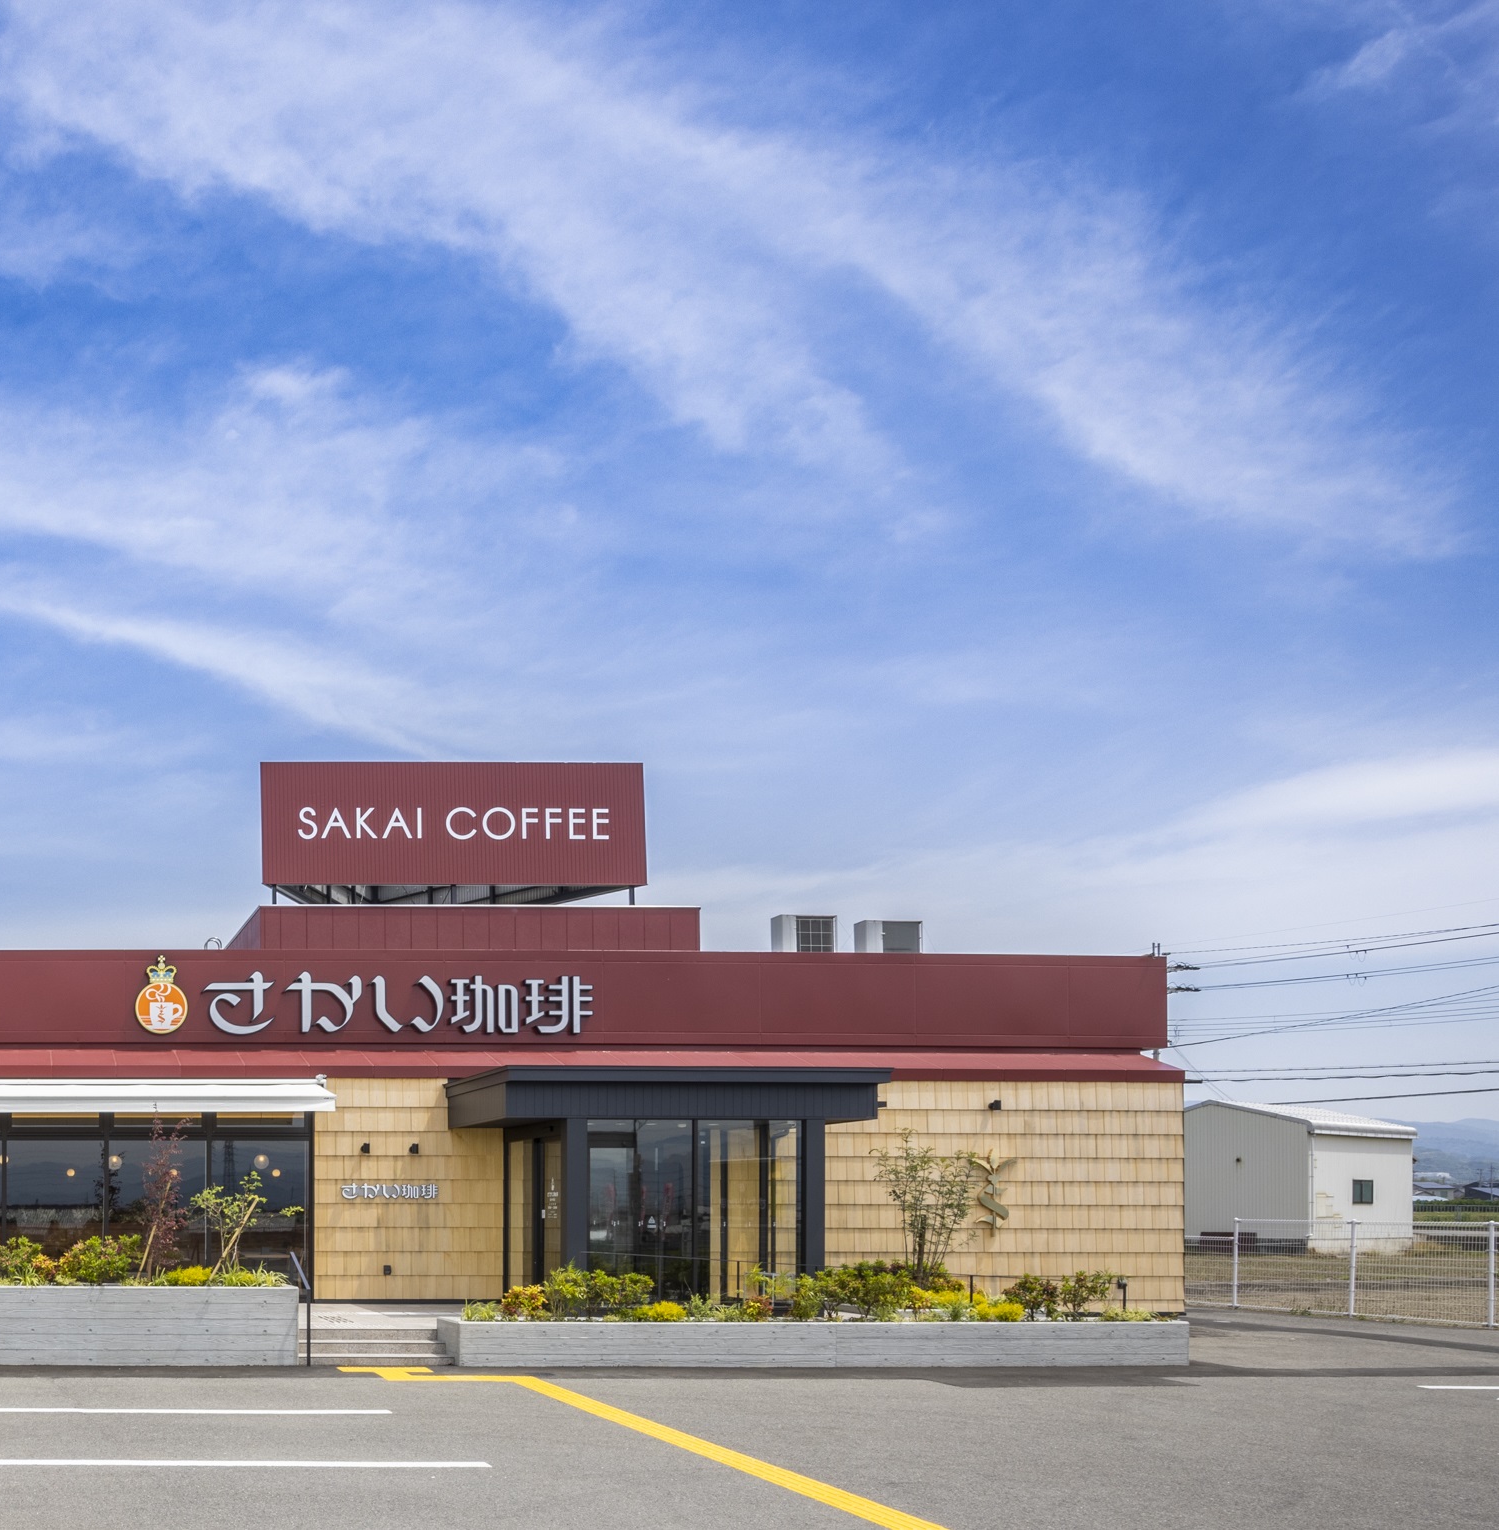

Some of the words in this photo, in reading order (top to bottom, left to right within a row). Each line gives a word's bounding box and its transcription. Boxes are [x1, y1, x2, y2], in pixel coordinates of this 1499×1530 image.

[297, 806, 423, 840] SAKAI
[445, 806, 610, 840] COFFEE
[202, 970, 594, 1035] さかい珈琲
[340, 1182, 439, 1199] さかい珈琲
